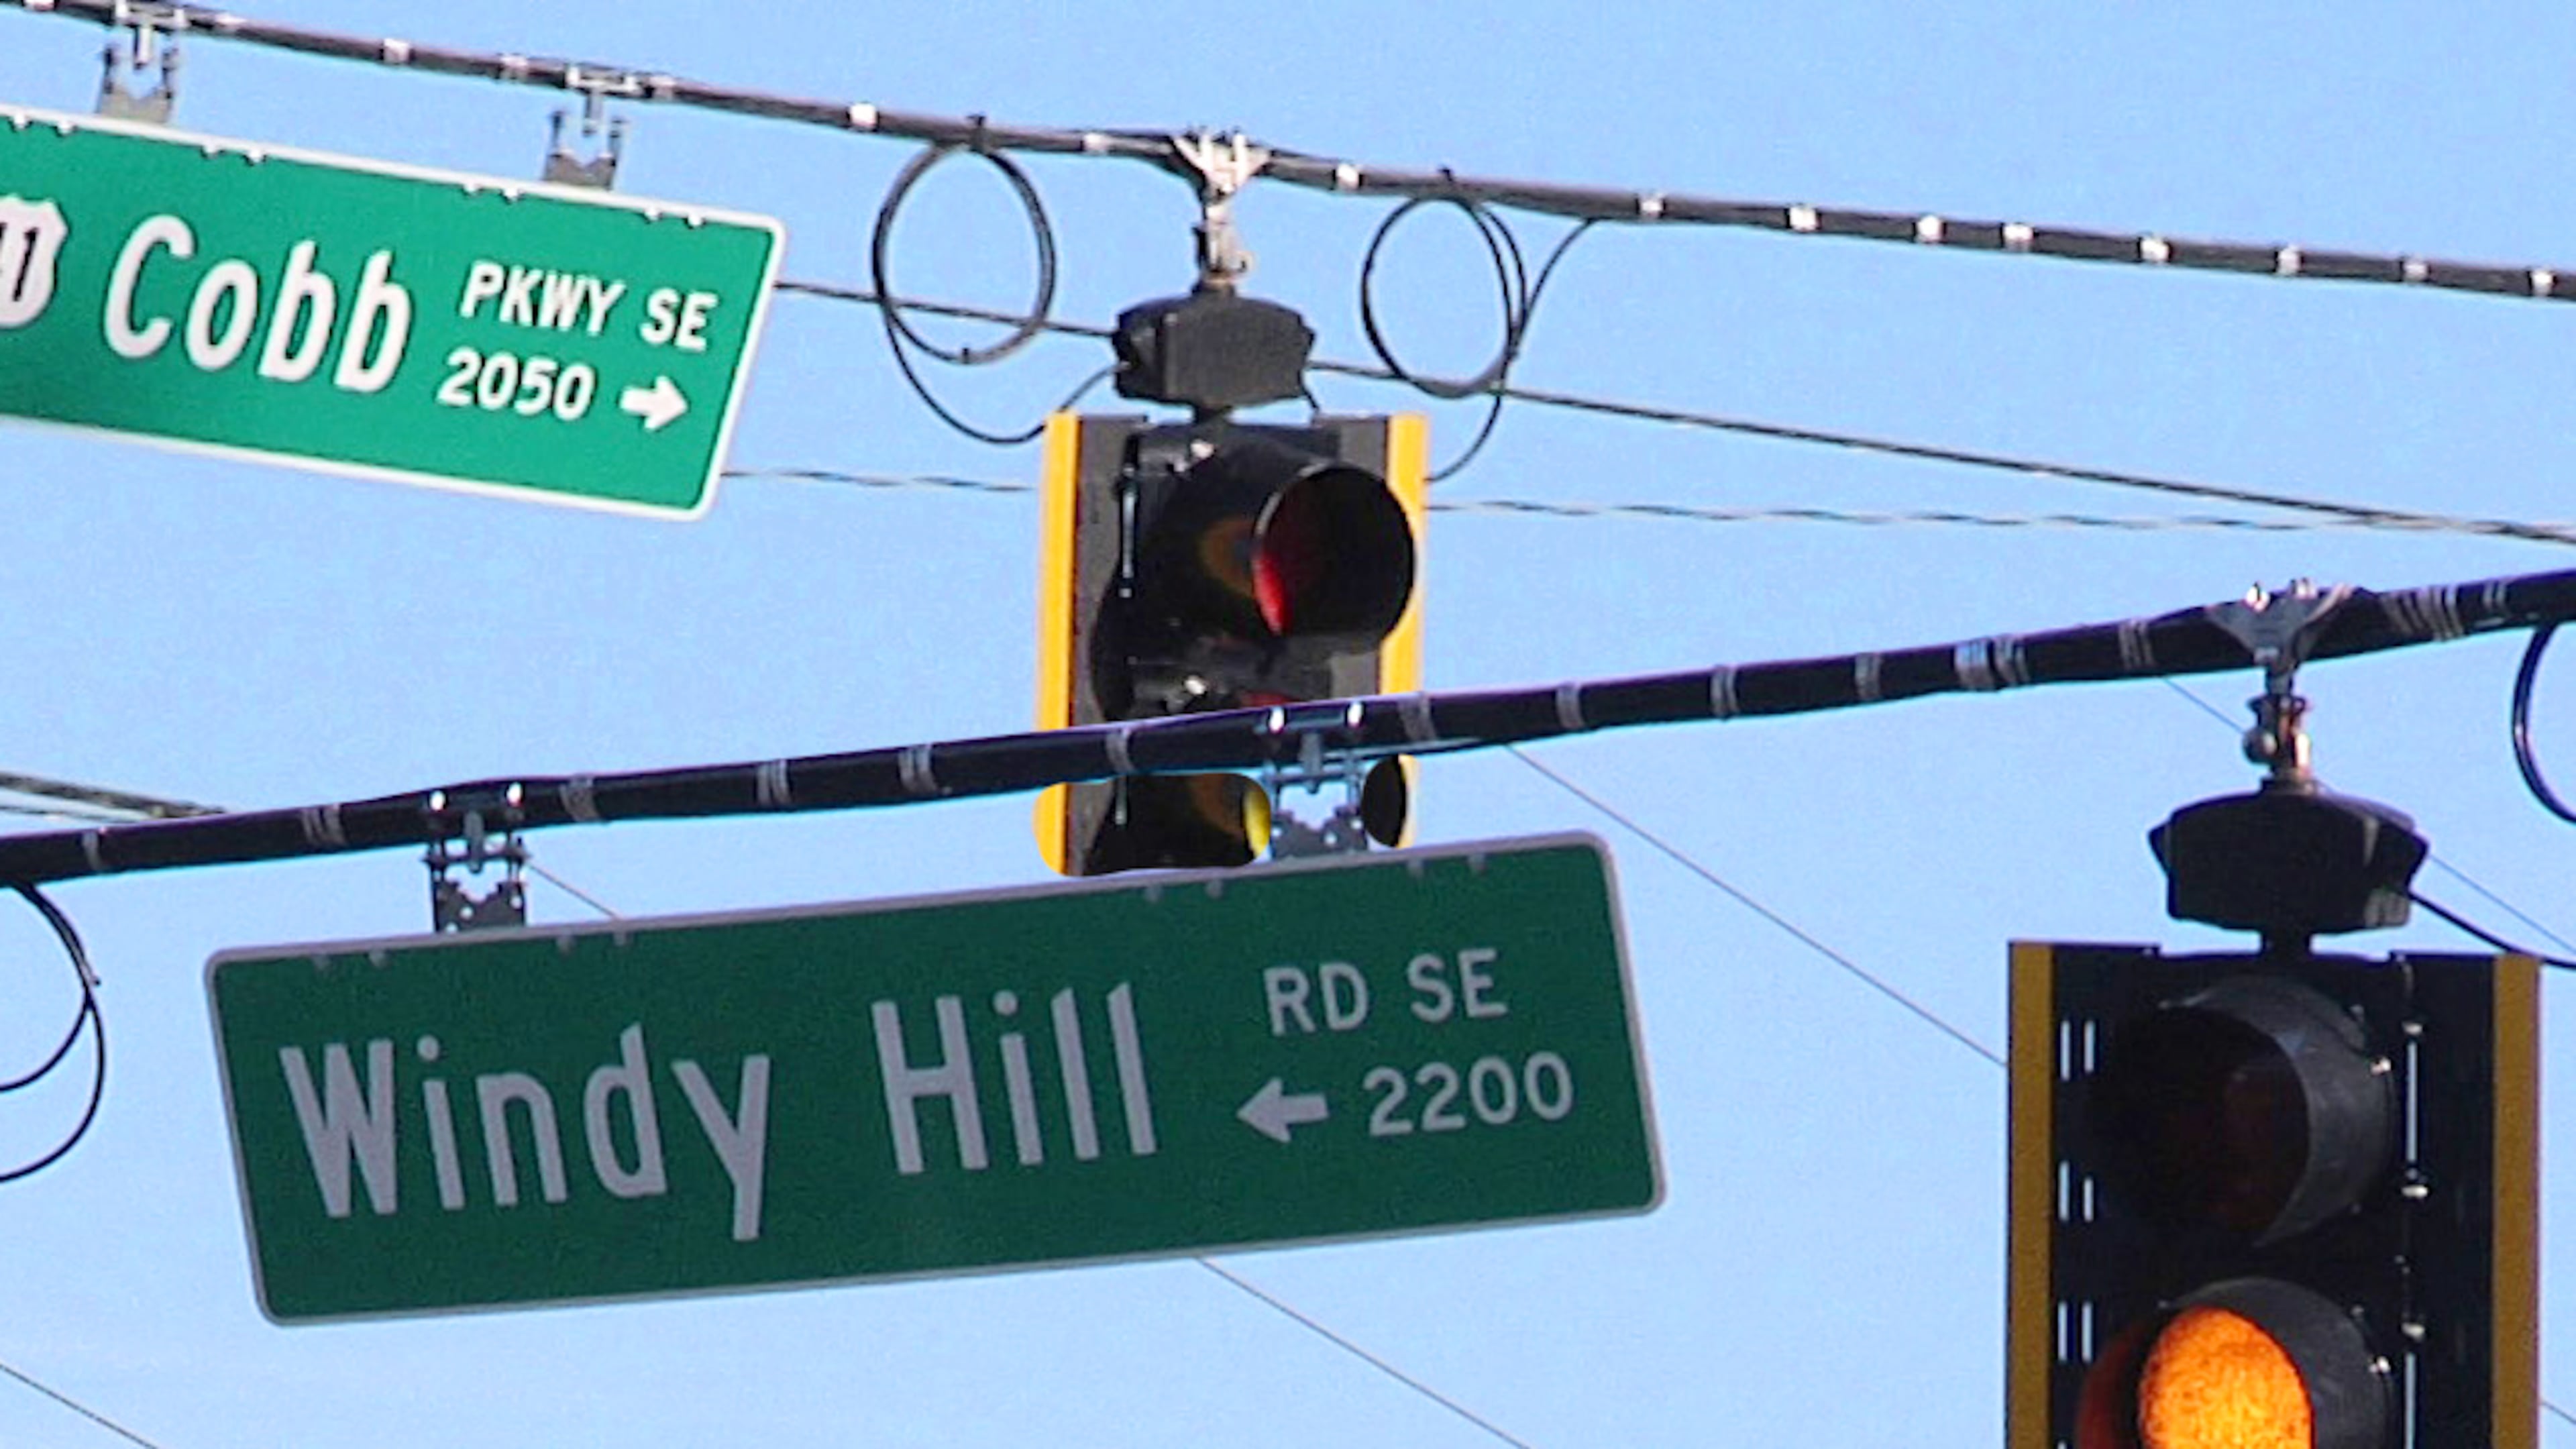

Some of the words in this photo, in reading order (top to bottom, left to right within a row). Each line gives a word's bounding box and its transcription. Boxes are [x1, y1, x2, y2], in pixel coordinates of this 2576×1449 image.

[105, 215, 411, 393] Cobb
[460, 260, 626, 336] PKWY
[640, 287, 718, 353] SE
[437, 346, 595, 421] 2050
[1265, 963, 1367, 1034] RD
[1408, 949, 1507, 1021] SE
[280, 1025, 769, 1240] Windy
[872, 983, 1157, 1174] Hill
[1364, 1053, 1572, 1136] 2200
